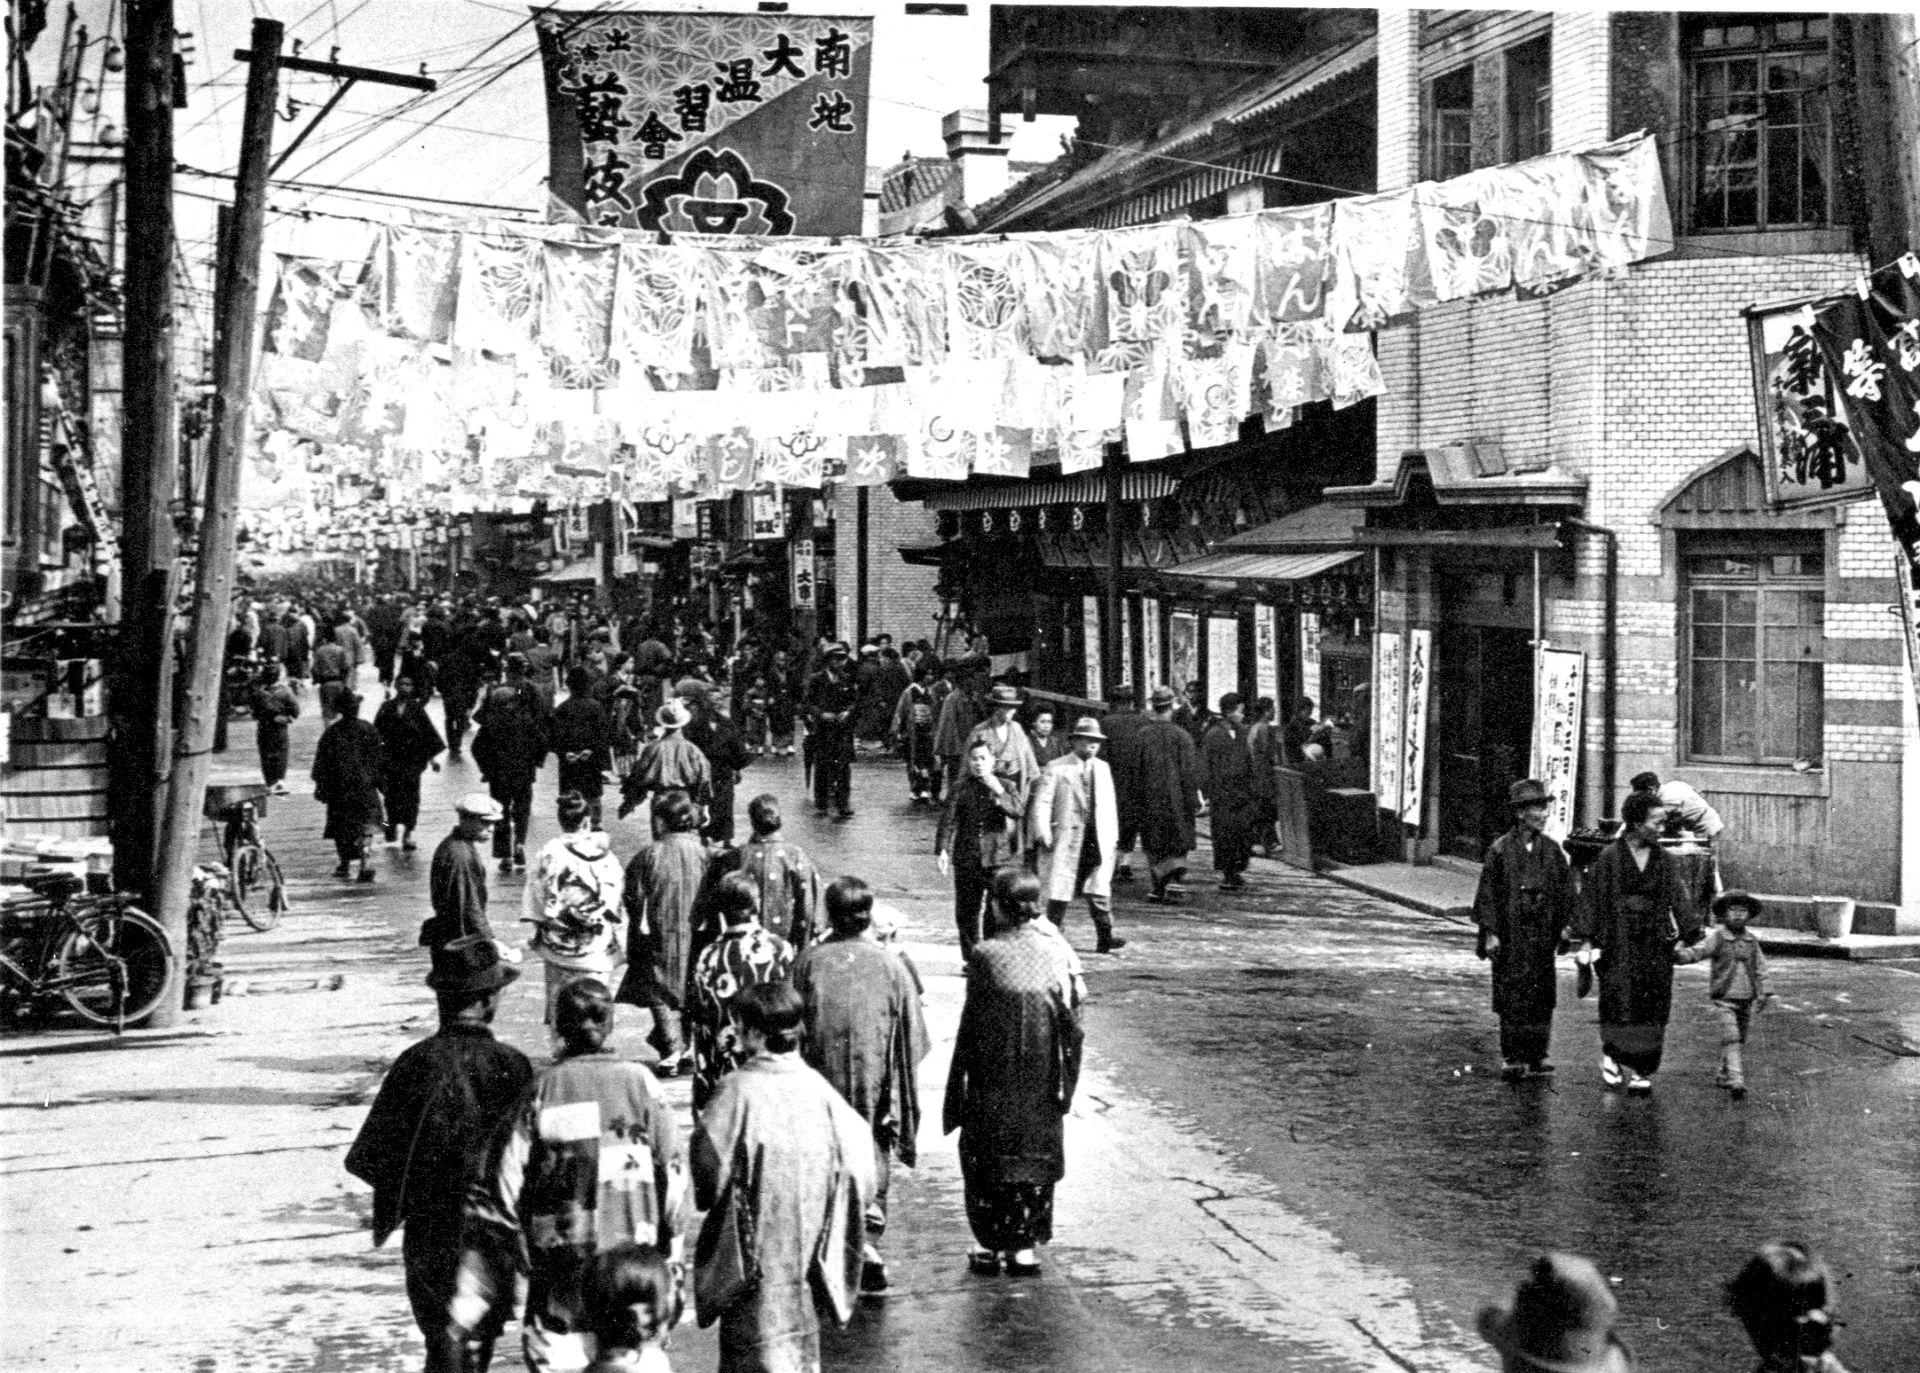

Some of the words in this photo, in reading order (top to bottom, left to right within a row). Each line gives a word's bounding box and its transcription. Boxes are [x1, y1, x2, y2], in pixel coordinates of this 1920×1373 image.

[633, 34, 806, 160] 大温習會
[808, 27, 854, 132] 南地
